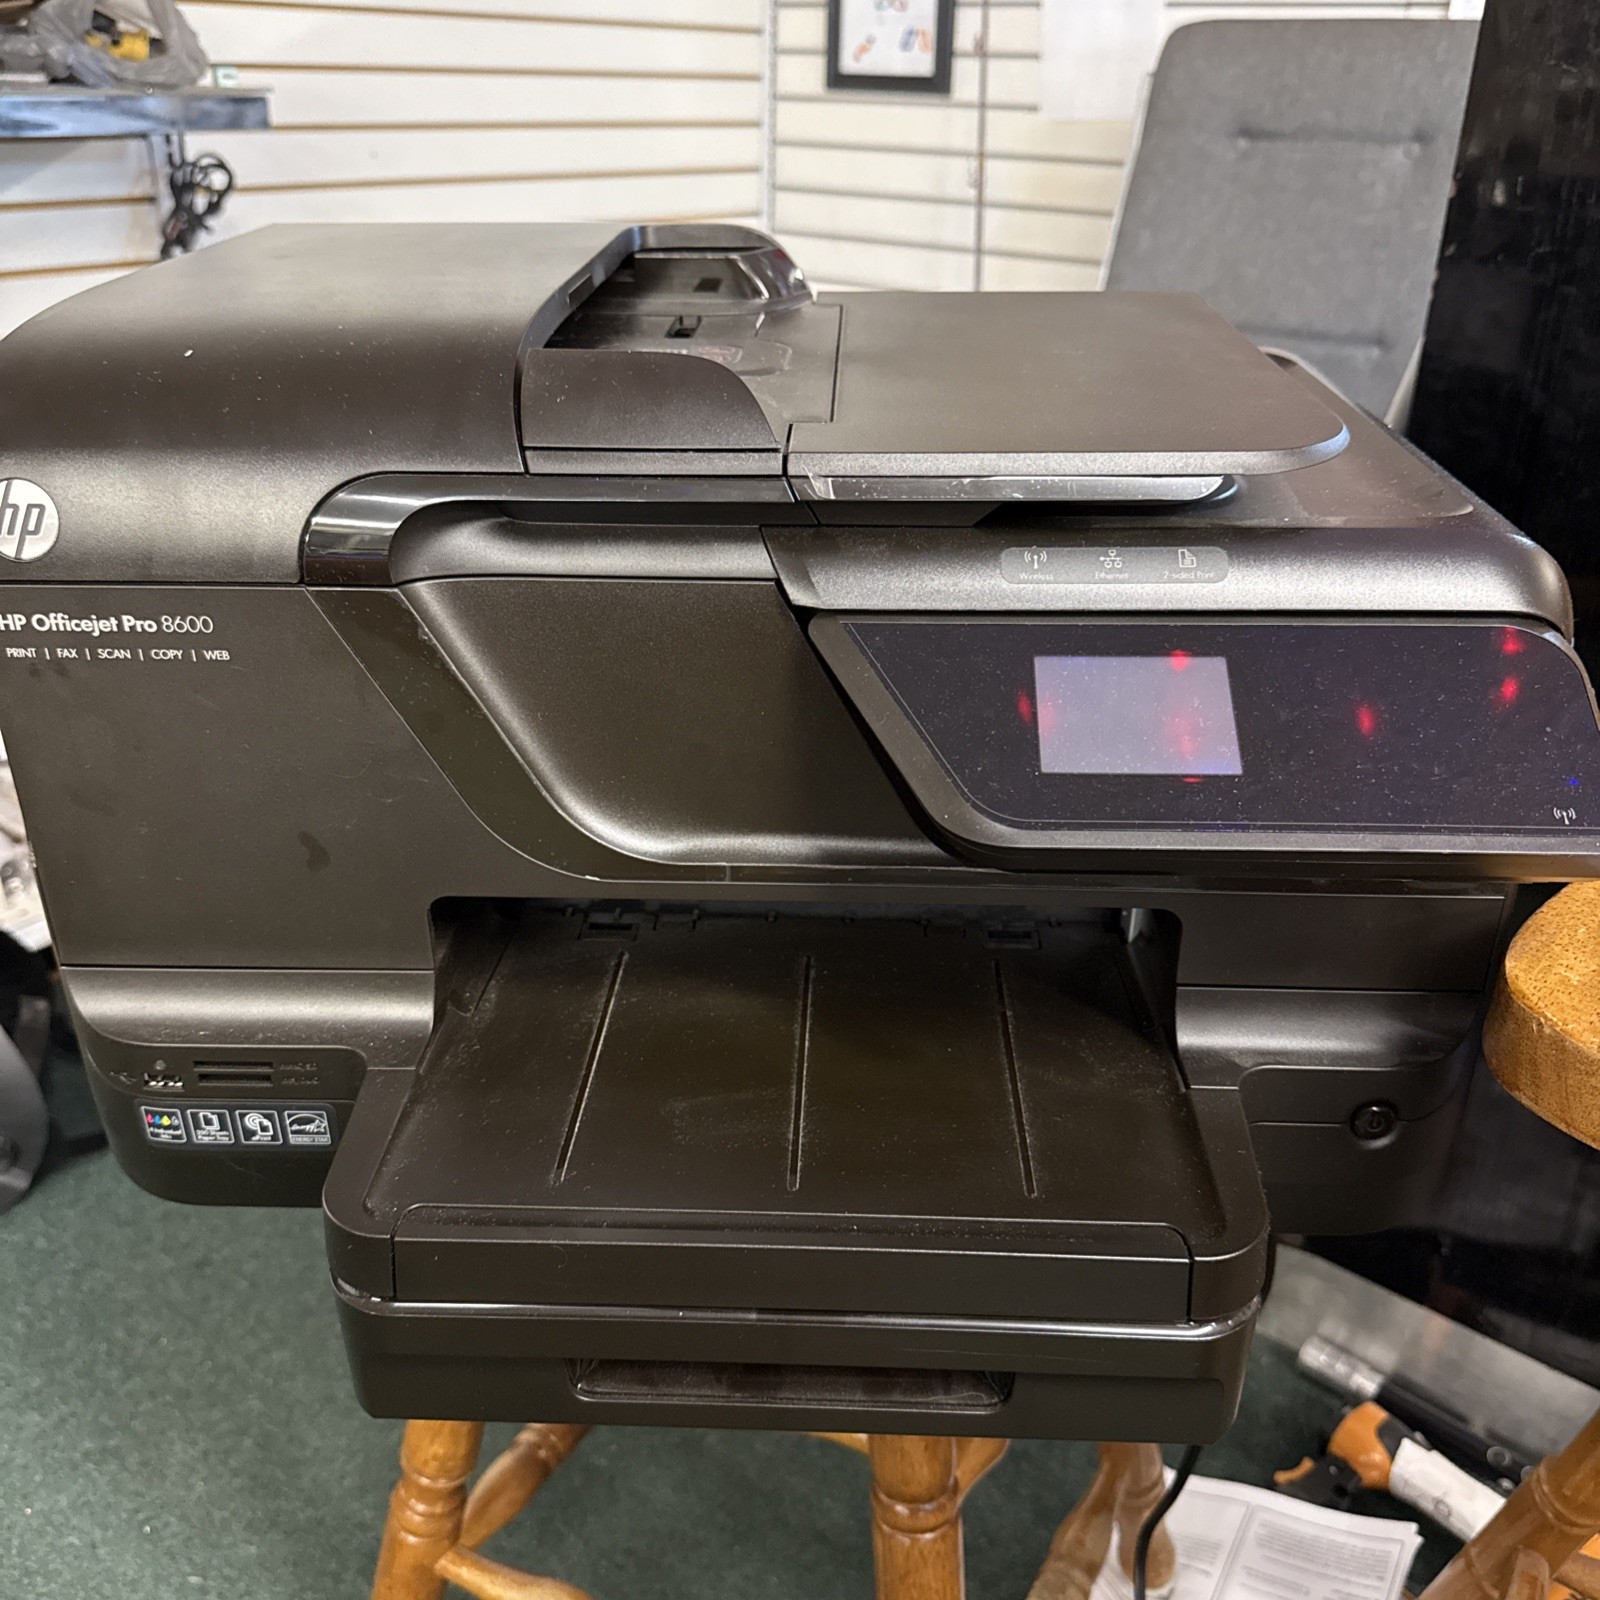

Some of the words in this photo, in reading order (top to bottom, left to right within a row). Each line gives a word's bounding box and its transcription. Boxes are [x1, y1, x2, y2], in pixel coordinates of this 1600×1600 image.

[0, 479, 46, 558] hp
[1019, 571, 1054, 581] Wireless
[1094, 571, 1129, 580] Ethernet
[0, 613, 27, 631] HP
[31, 612, 119, 637] Officejet
[121, 614, 158, 633] Pro
[161, 615, 214, 634] 8600
[5, 647, 37, 658] PRINT
[56, 648, 79, 659] FAX
[97, 648, 132, 660] SCAN
[151, 648, 184, 660] COPY
[203, 650, 230, 661] WEB
